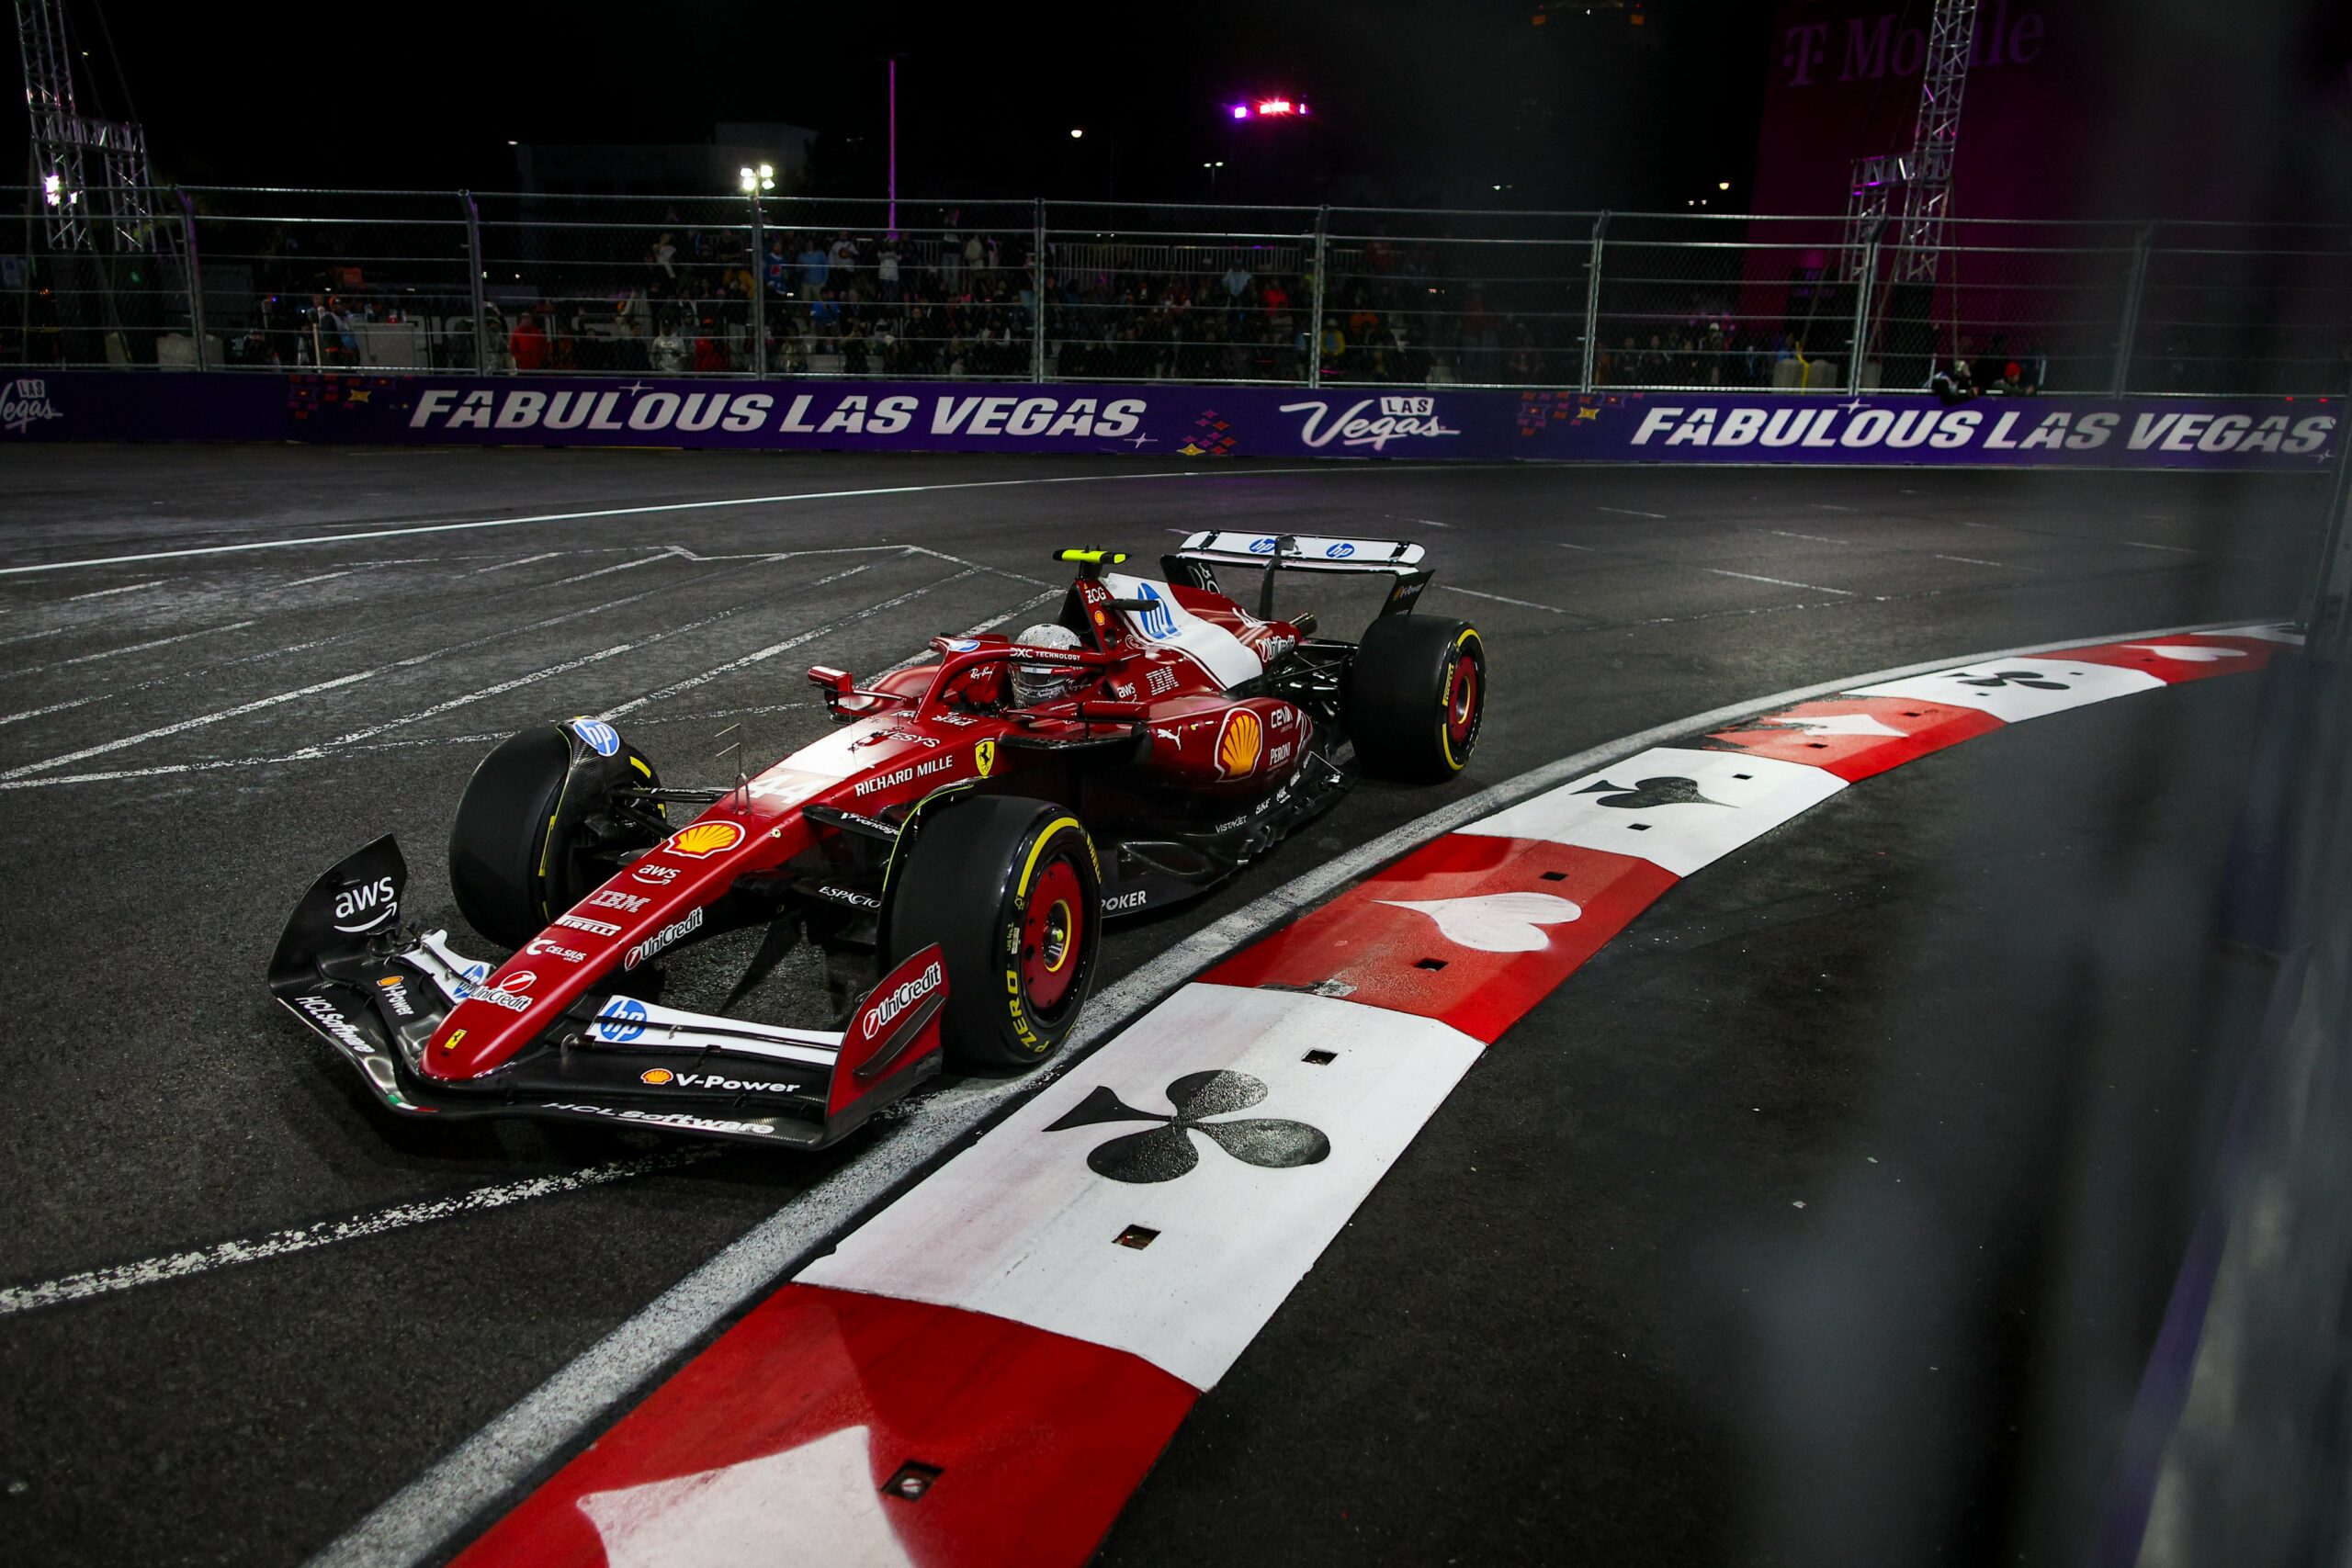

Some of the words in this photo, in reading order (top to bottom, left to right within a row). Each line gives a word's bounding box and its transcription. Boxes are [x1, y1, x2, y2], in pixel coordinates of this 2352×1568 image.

[1838, 0, 2043, 81] Moile
[19, 380, 43, 396] LAS
[410, 390, 774, 432] FABULOUS
[779, 394, 919, 434] LAS
[930, 396, 1147, 437] VEGAS
[1385, 398, 1430, 414] LAS
[1279, 399, 1460, 451] Vegas
[1631, 407, 1983, 449] FABULOUS
[1983, 411, 2120, 450] LAS
[2126, 412, 2336, 454] VEGAS
[1252, 538, 1275, 553] hp
[1329, 543, 1352, 558] hp
[1085, 587, 1107, 604] ZCG
[1010, 648, 1034, 659] DXC
[1035, 651, 1081, 661] TECHNOLOGY
[1116, 682, 1136, 698] aws
[1146, 666, 1180, 696] IBM
[579, 720, 615, 756] hp
[854, 768, 913, 797] RICHARD
[917, 755, 954, 778] MILLE
[636, 864, 681, 880] aws
[334, 876, 395, 919] aws
[589, 890, 651, 913] IBM
[818, 886, 881, 908] ESPACIO
[555, 915, 622, 937] PIRELLI
[640, 907, 703, 960] UniCredit
[546, 945, 587, 961] CELSIUS
[382, 983, 415, 1016] V-Power
[470, 986, 534, 1012] UniCredit
[879, 962, 942, 1026] UniCredit
[606, 1000, 646, 1041] hp
[675, 1073, 801, 1093] V-Power
